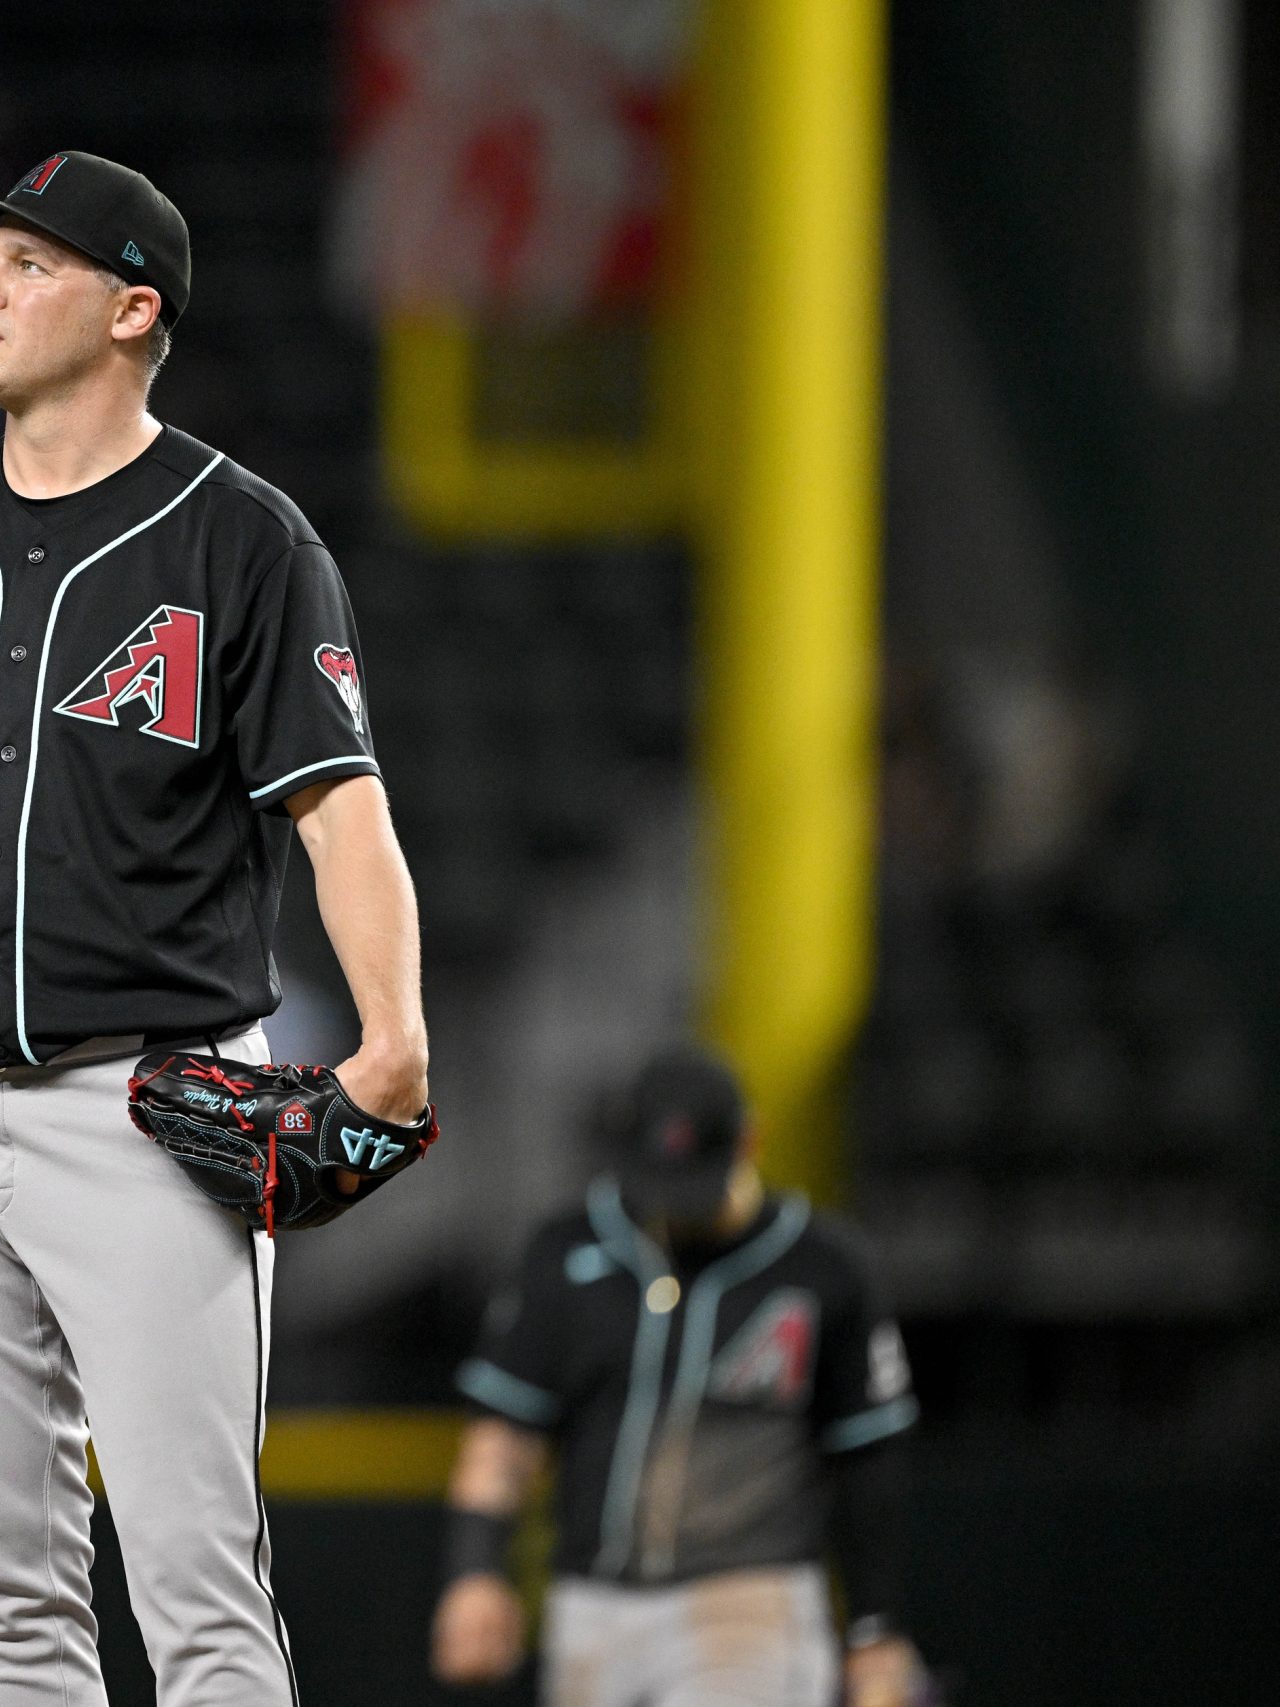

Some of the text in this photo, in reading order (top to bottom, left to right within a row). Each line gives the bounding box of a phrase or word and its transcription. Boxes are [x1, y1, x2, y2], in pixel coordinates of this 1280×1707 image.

[52, 604, 204, 749] A
[222, 1098, 233, 1113] &
[284, 1112, 306, 1129] 38
[340, 1126, 405, 1170] 44
